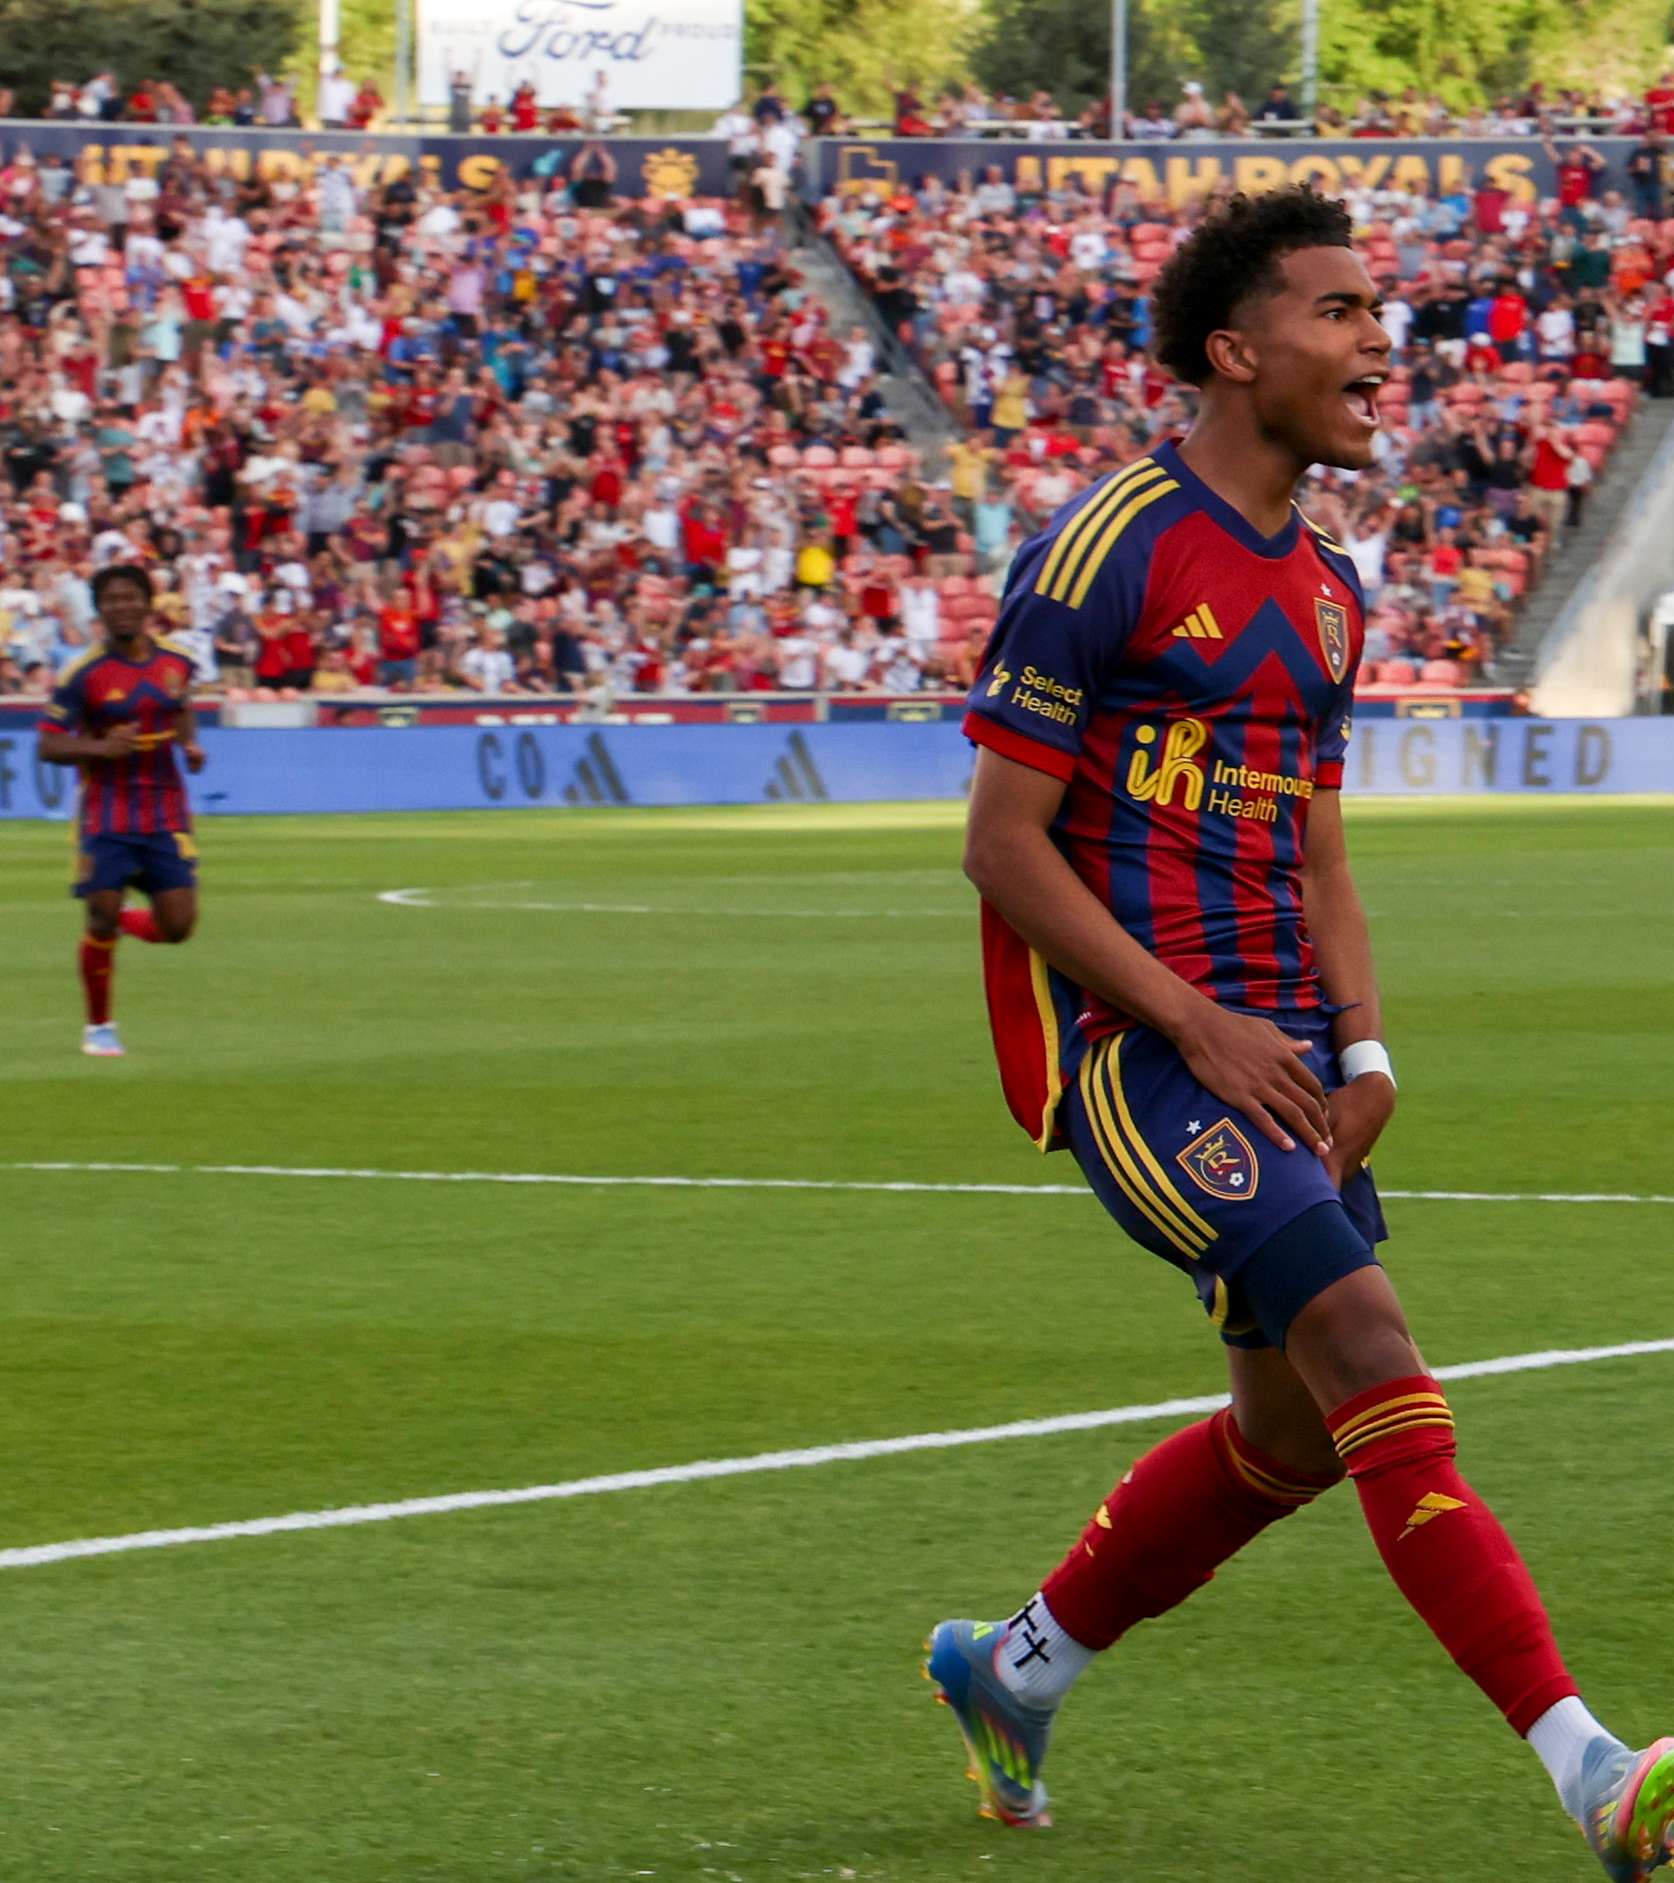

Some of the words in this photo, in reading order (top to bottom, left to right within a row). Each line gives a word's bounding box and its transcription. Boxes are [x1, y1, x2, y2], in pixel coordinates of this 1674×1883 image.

[498, 0, 658, 60] Ford
[1015, 156, 1222, 212] UTAH
[1234, 154, 1537, 206] ROYALS
[1010, 686, 1077, 726] Health
[1020, 665, 1082, 706] Select
[1207, 789, 1278, 823] Health
